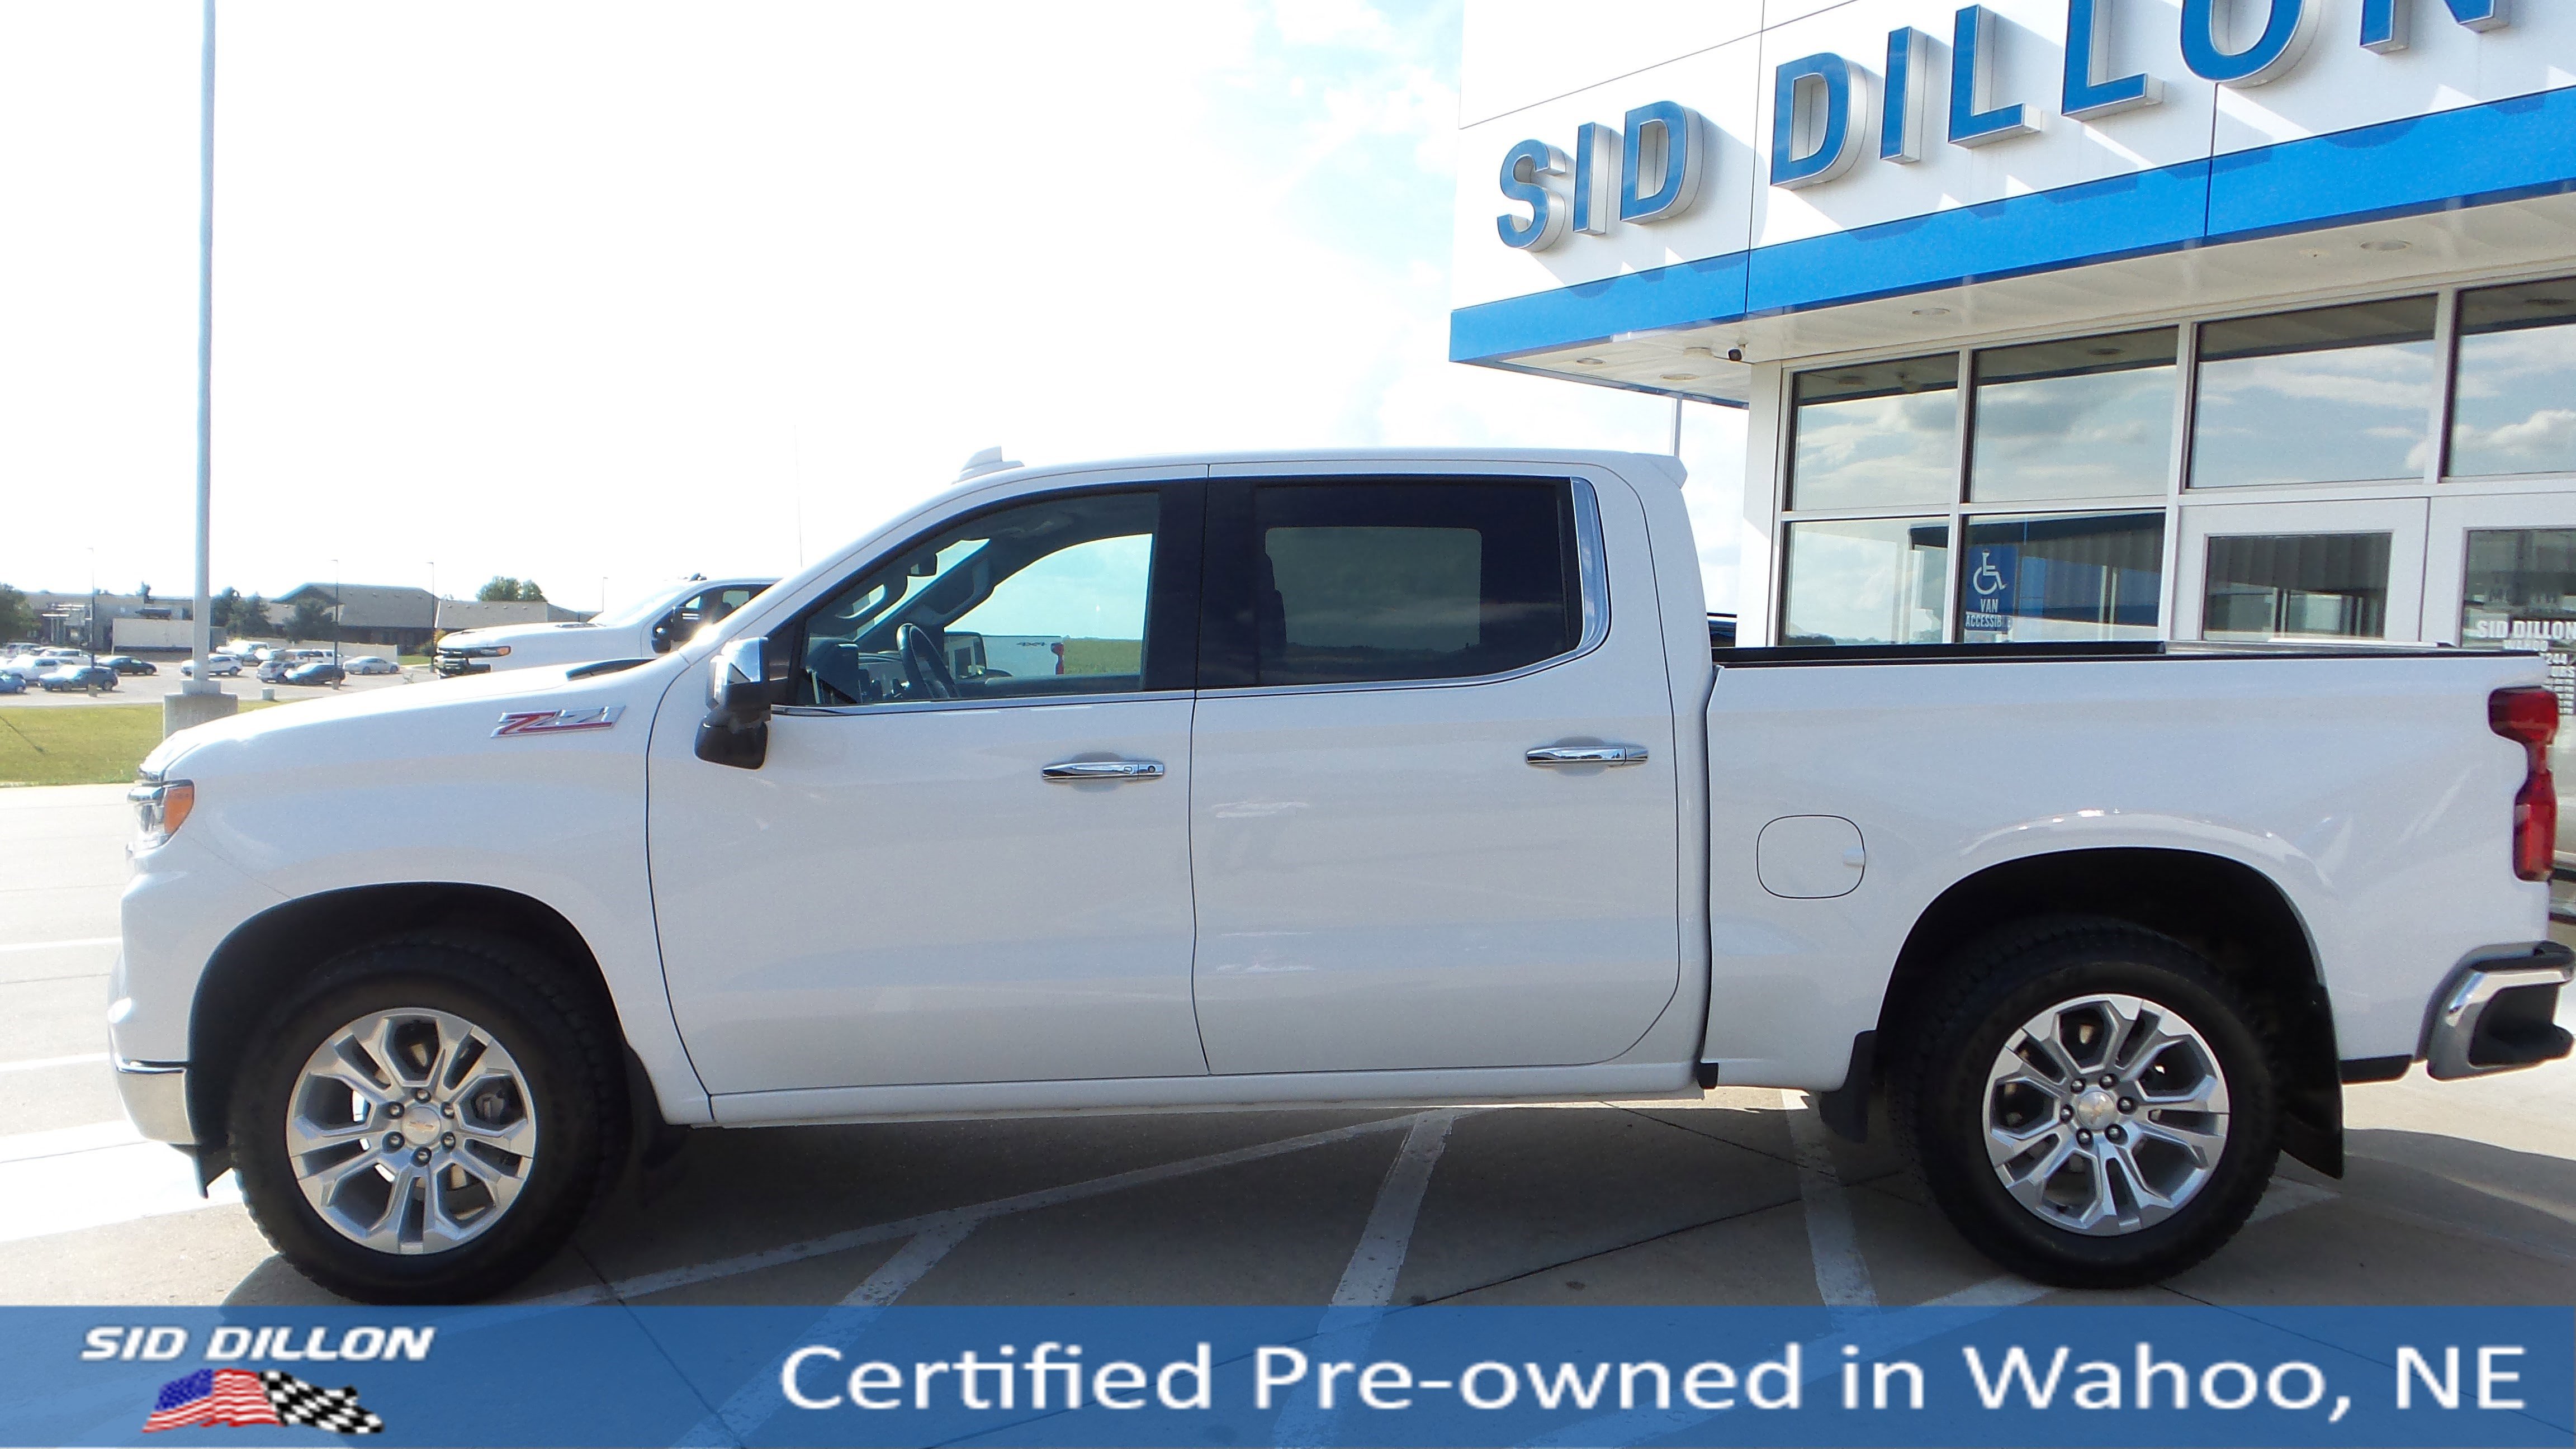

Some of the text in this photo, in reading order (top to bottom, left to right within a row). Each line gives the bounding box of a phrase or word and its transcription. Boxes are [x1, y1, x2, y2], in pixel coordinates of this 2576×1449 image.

[1497, 0, 2509, 252] SID DILLO
[1980, 598, 1999, 613] VAN
[2476, 620, 2509, 638] SID
[490, 705, 626, 738] Z71
